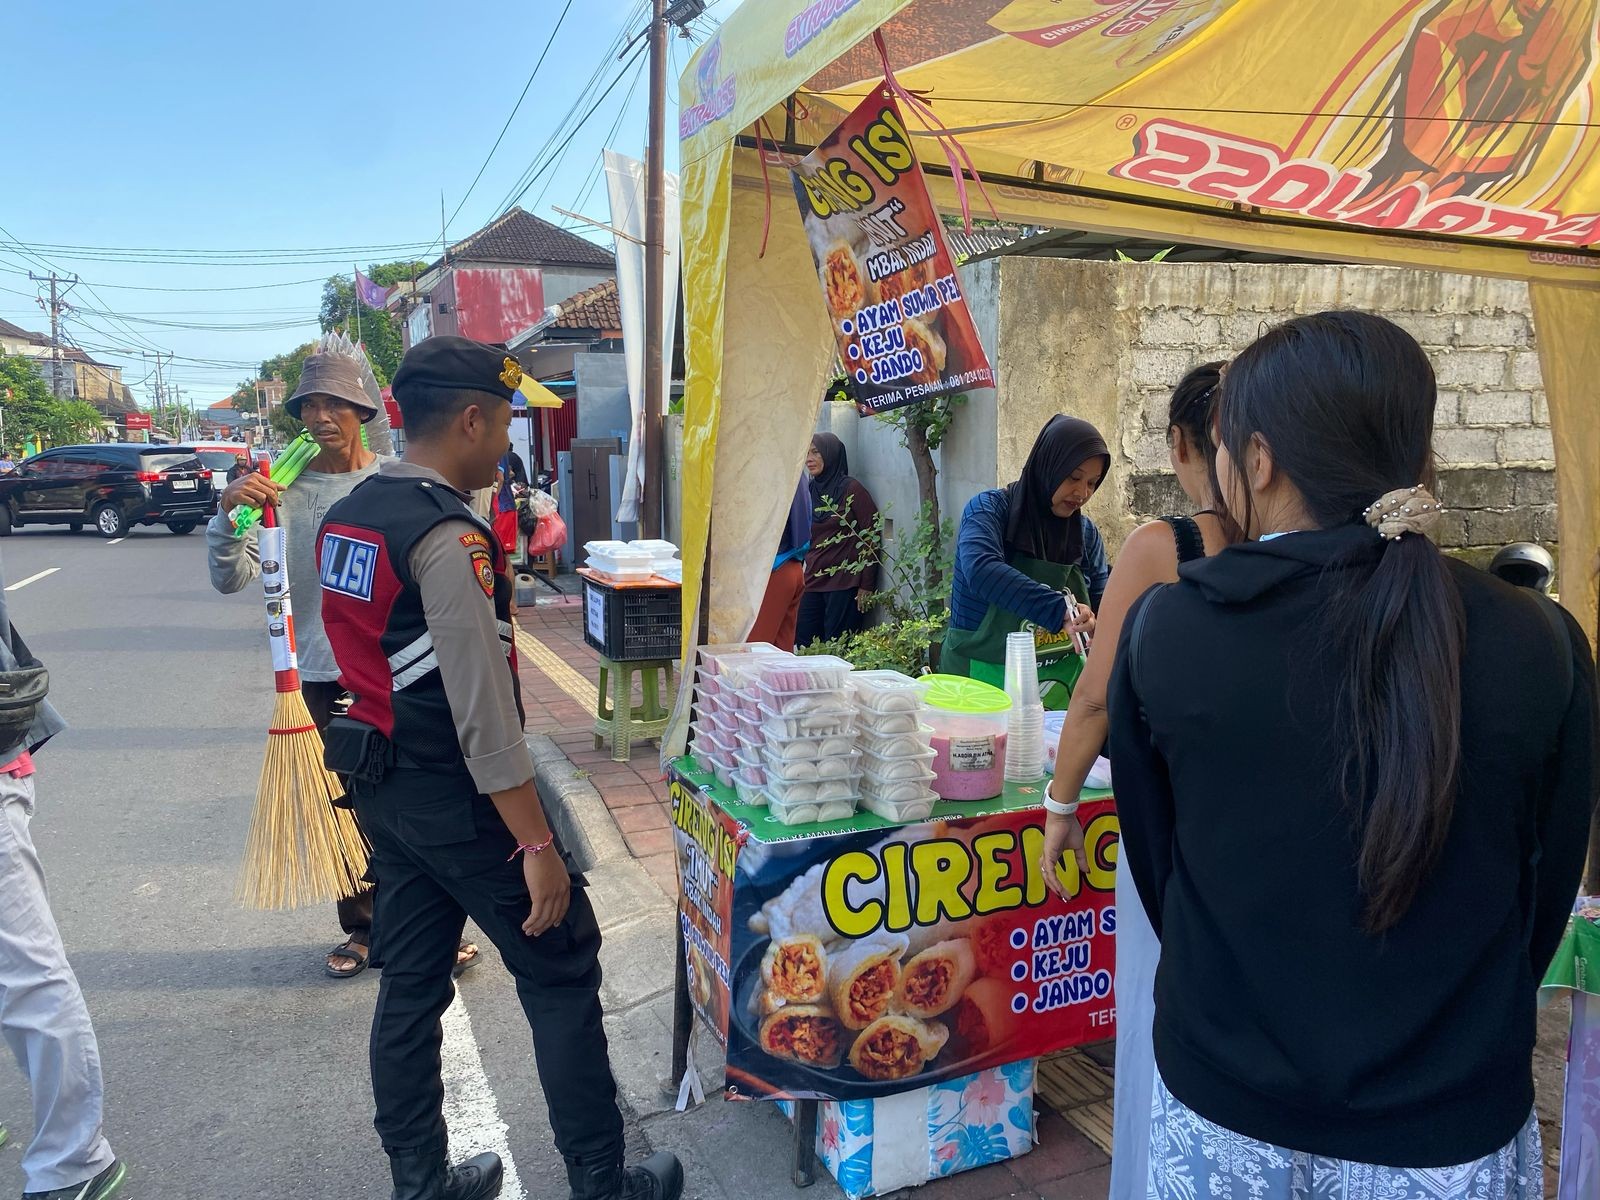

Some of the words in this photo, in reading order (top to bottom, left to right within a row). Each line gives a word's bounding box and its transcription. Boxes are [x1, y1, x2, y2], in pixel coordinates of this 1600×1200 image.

[867, 247, 908, 283] MBAK
[856, 298, 903, 335] AYAM
[861, 325, 906, 360] KEJU
[870, 347, 924, 384] JANDO
[866, 390, 904, 409] TERIMA
[821, 812, 1117, 939] CIRENG
[700, 896, 722, 936] INDAH
[1032, 907, 1096, 950] AYAM
[1032, 940, 1092, 982] KEJU
[1032, 969, 1112, 1014] JANDO
